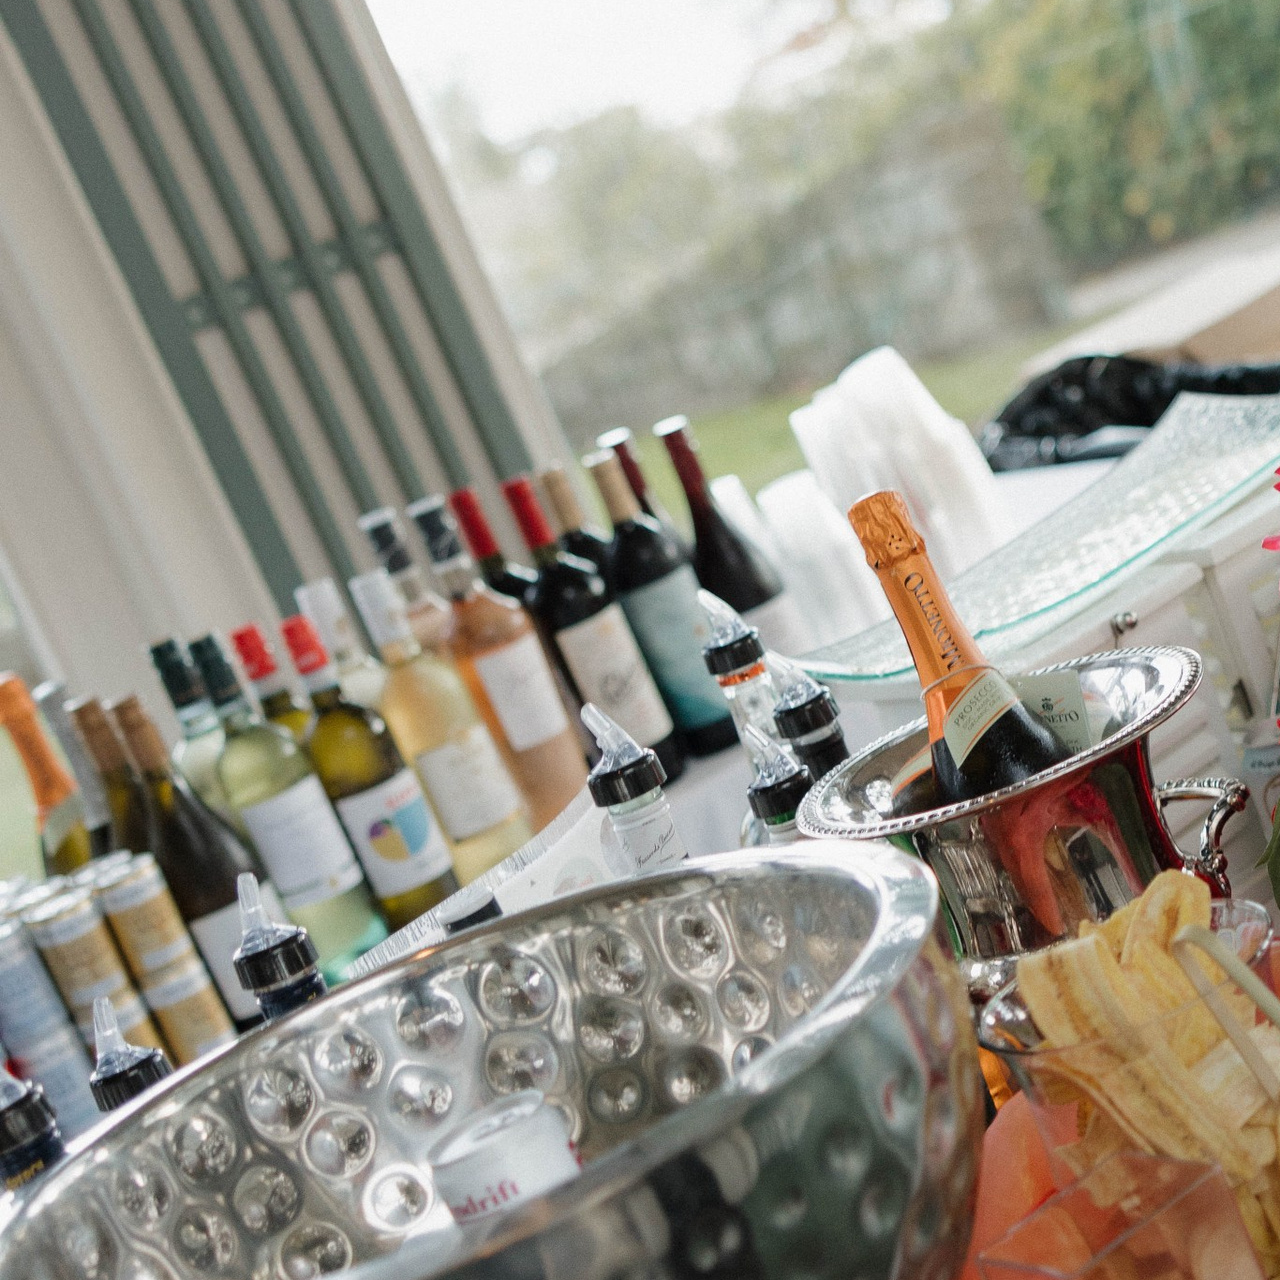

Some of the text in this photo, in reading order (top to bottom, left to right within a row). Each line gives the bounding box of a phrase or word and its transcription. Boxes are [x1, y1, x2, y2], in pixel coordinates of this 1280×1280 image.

[904, 572, 966, 671] MIONETTO
[954, 681, 998, 727] PROSECCO
[1041, 710, 1080, 724] NETTO
